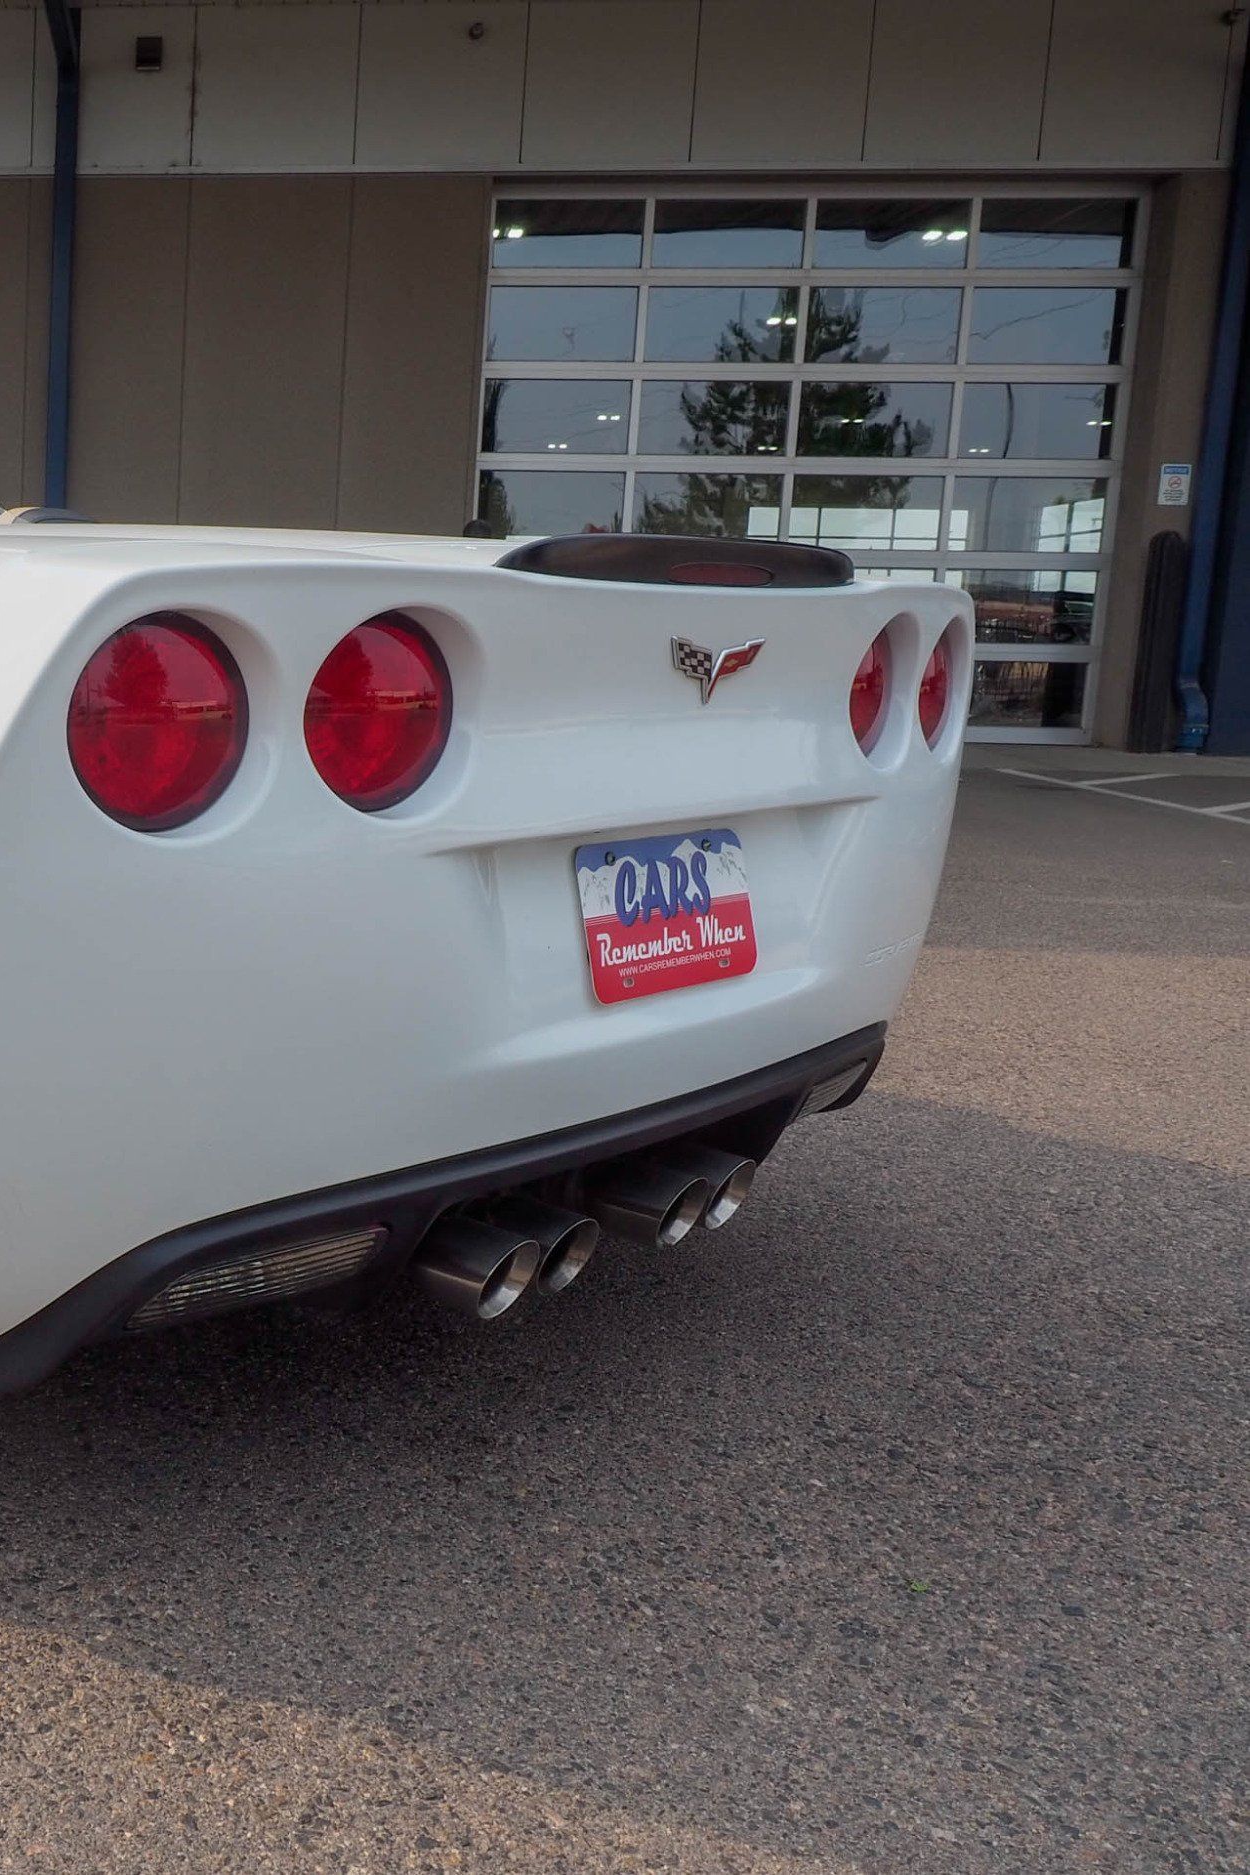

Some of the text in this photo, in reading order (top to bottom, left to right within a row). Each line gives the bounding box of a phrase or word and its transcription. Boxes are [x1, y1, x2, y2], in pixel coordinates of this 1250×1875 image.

[615, 851, 711, 926] CARS
[596, 914, 746, 967] Remember When
[618, 947, 731, 977] WWW.CARSREMEMBERWHEN.COM
